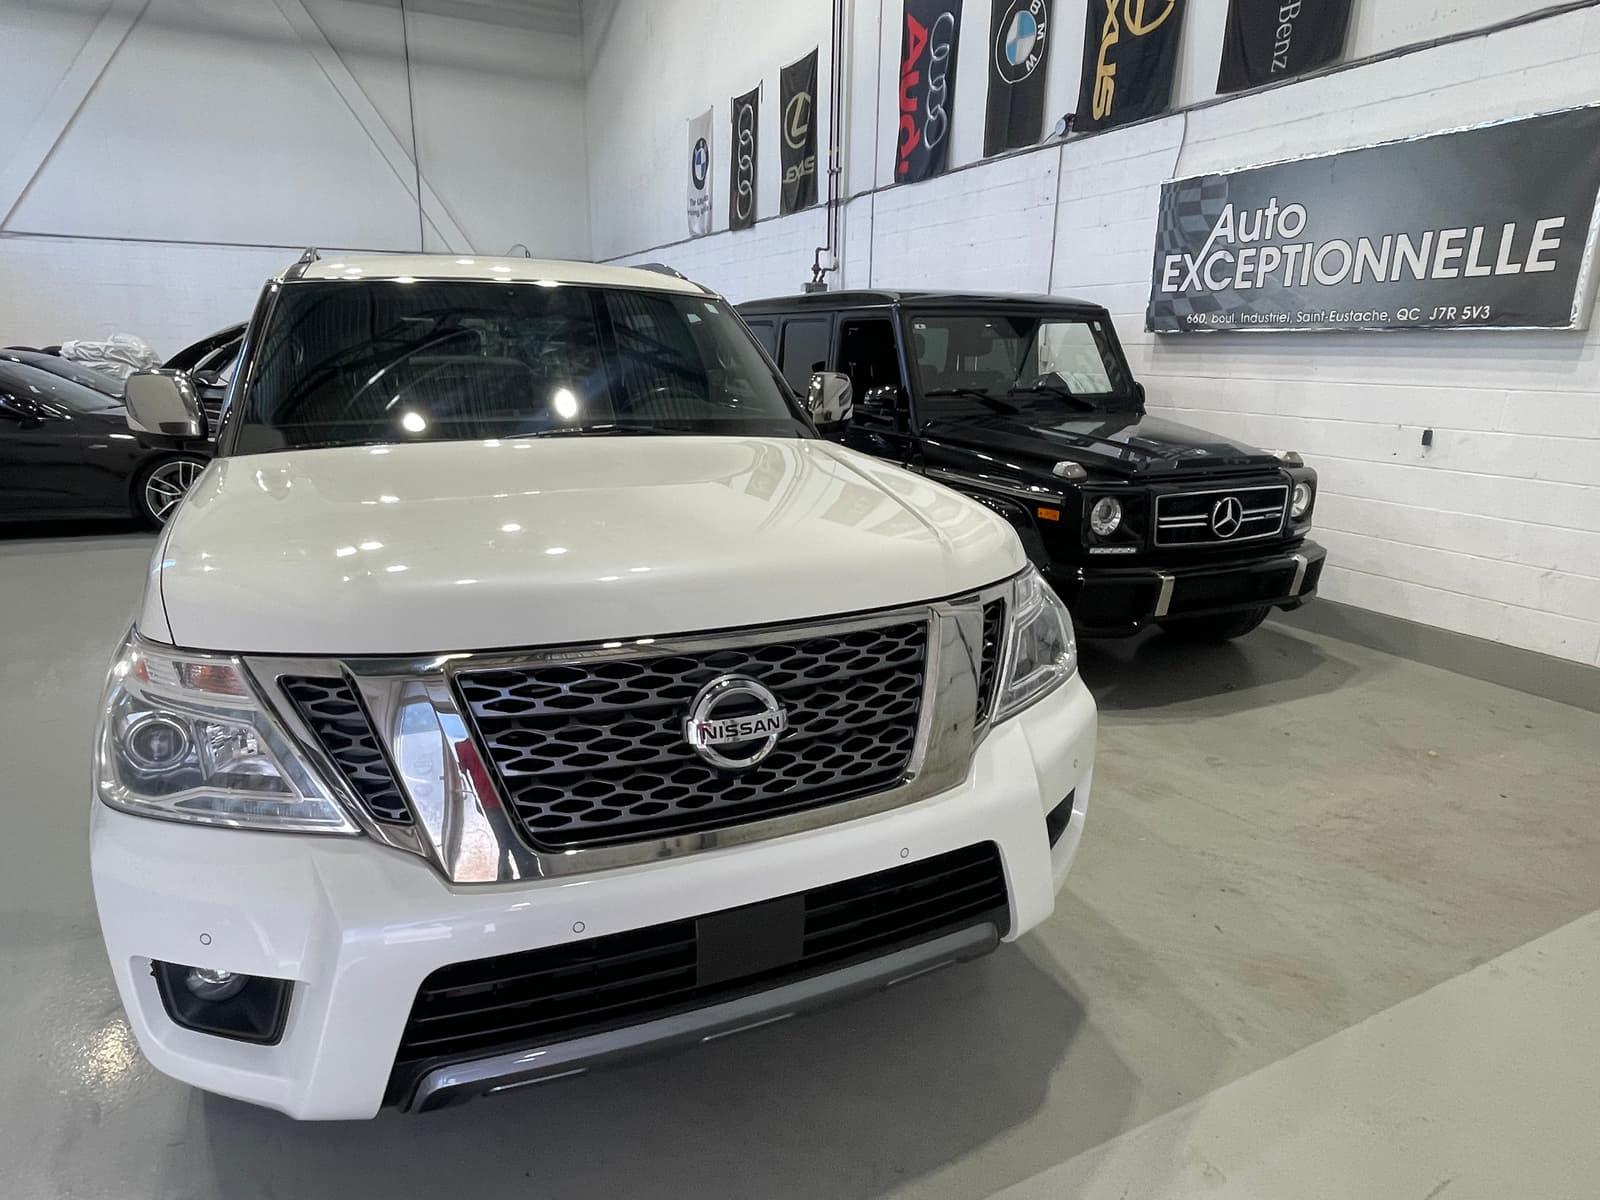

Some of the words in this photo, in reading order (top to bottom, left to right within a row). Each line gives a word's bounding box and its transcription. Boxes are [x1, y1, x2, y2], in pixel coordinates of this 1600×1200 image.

[1207, 196, 1308, 245] Auto
[1161, 215, 1567, 293] EXCEPTIONNELLE
[1296, 308, 1392, 324] Saint-Eustache,
[1396, 307, 1422, 321] QC
[1429, 305, 1458, 321] J7R
[1461, 304, 1491, 320] 5V3
[699, 714, 781, 741] NISSAN
